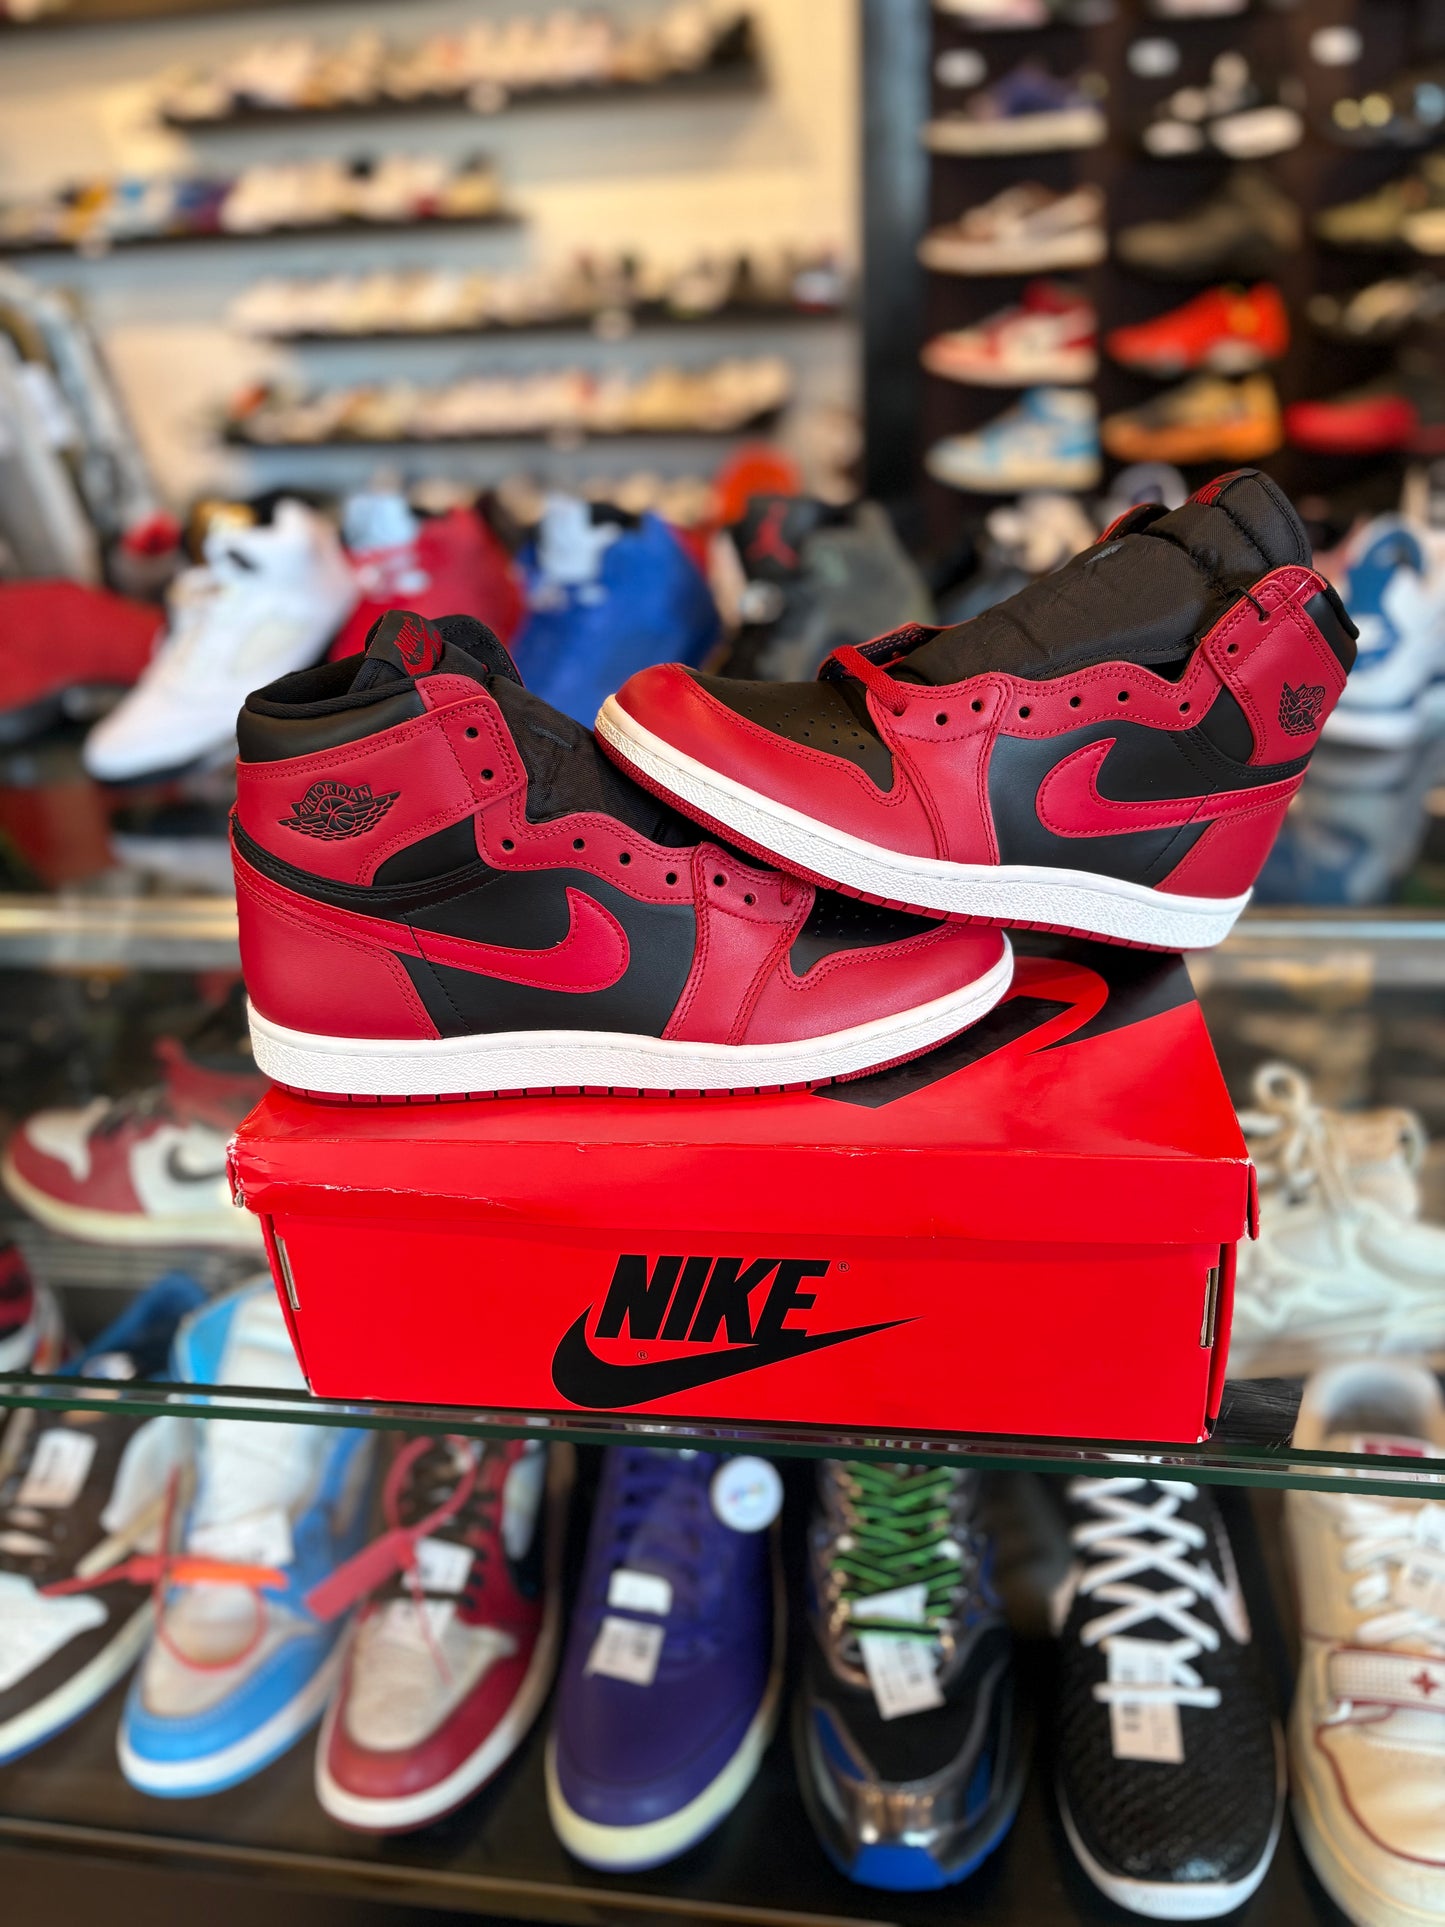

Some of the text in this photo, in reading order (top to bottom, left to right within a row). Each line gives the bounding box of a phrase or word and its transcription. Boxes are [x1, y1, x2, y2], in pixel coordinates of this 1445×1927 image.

[393, 620, 424, 661] NIKE
[299, 783, 372, 815] AIR JORDAN
[594, 1253, 832, 1345] NIKE
